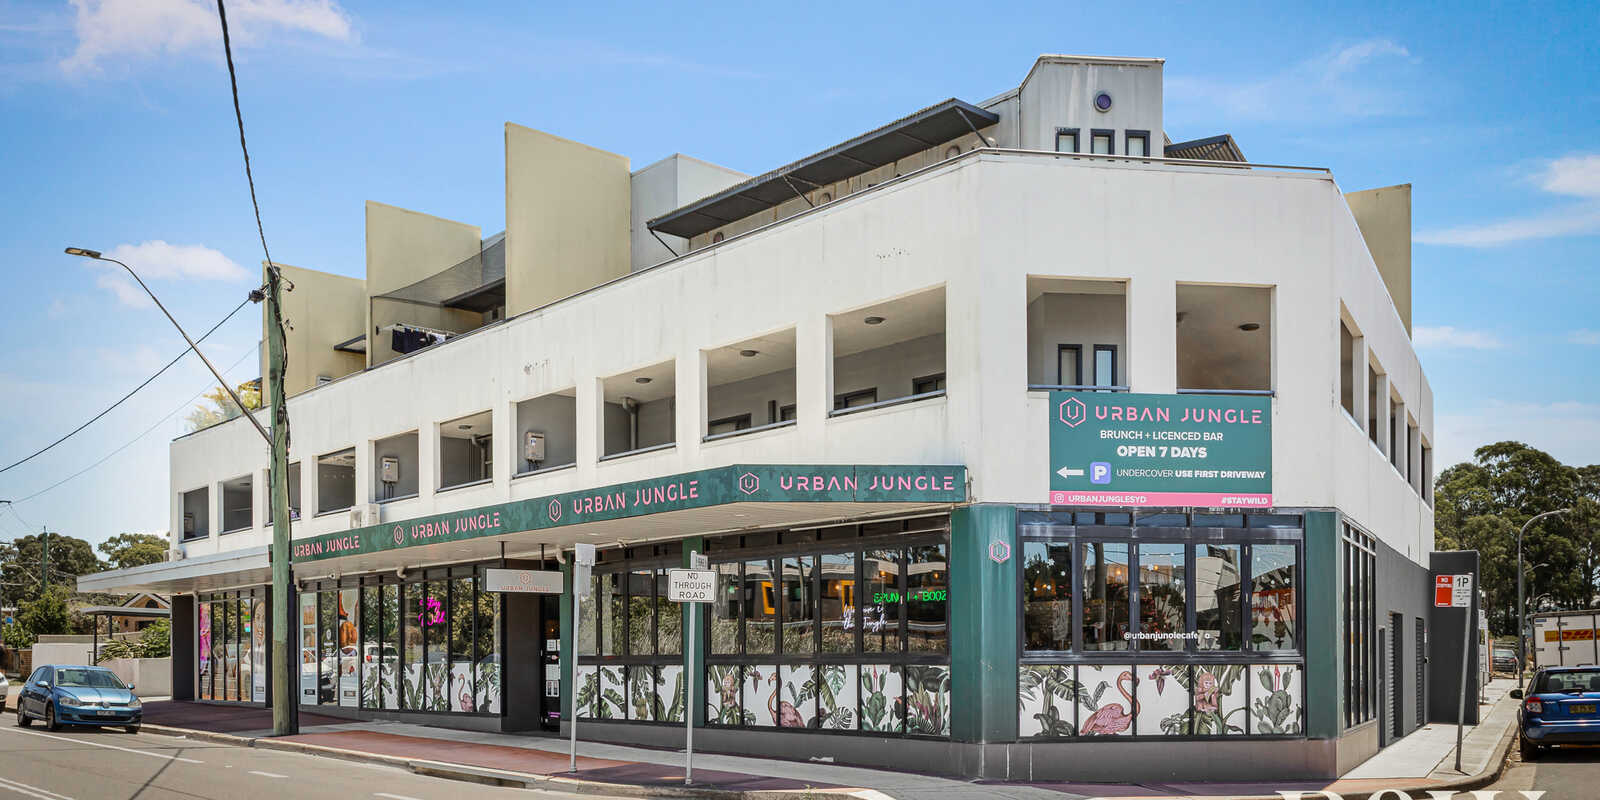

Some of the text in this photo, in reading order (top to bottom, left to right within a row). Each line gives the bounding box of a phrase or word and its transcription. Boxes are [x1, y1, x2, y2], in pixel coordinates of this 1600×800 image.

[1095, 406, 1169, 422] URBAN
[1181, 407, 1262, 424] JUNGLE
[1100, 430, 1143, 439] BRUNCH
[1153, 431, 1201, 440] LICENCED
[1203, 432, 1223, 441] BAR
[1117, 446, 1207, 458] OPEN 7 DAYS
[1094, 465, 1266, 481] P UNDERCOVER USE FIRST DRIVEWAY
[780, 476, 858, 490] URBAN
[870, 476, 954, 491] JUNGLE
[573, 492, 626, 514] URBAN
[633, 480, 699, 506] JUNGLE
[1068, 495, 1147, 504] URBANJUNGLESYD
[1222, 497, 1268, 505] #STAYWILD
[411, 520, 450, 539] URBAN
[455, 512, 500, 533] JUNGLE
[294, 535, 360, 557] URBAN JUNGLE
[687, 572, 698, 580] NO
[674, 581, 712, 590] THROUGH
[1456, 577, 1469, 588] 1P
[680, 591, 706, 599] ROAD
